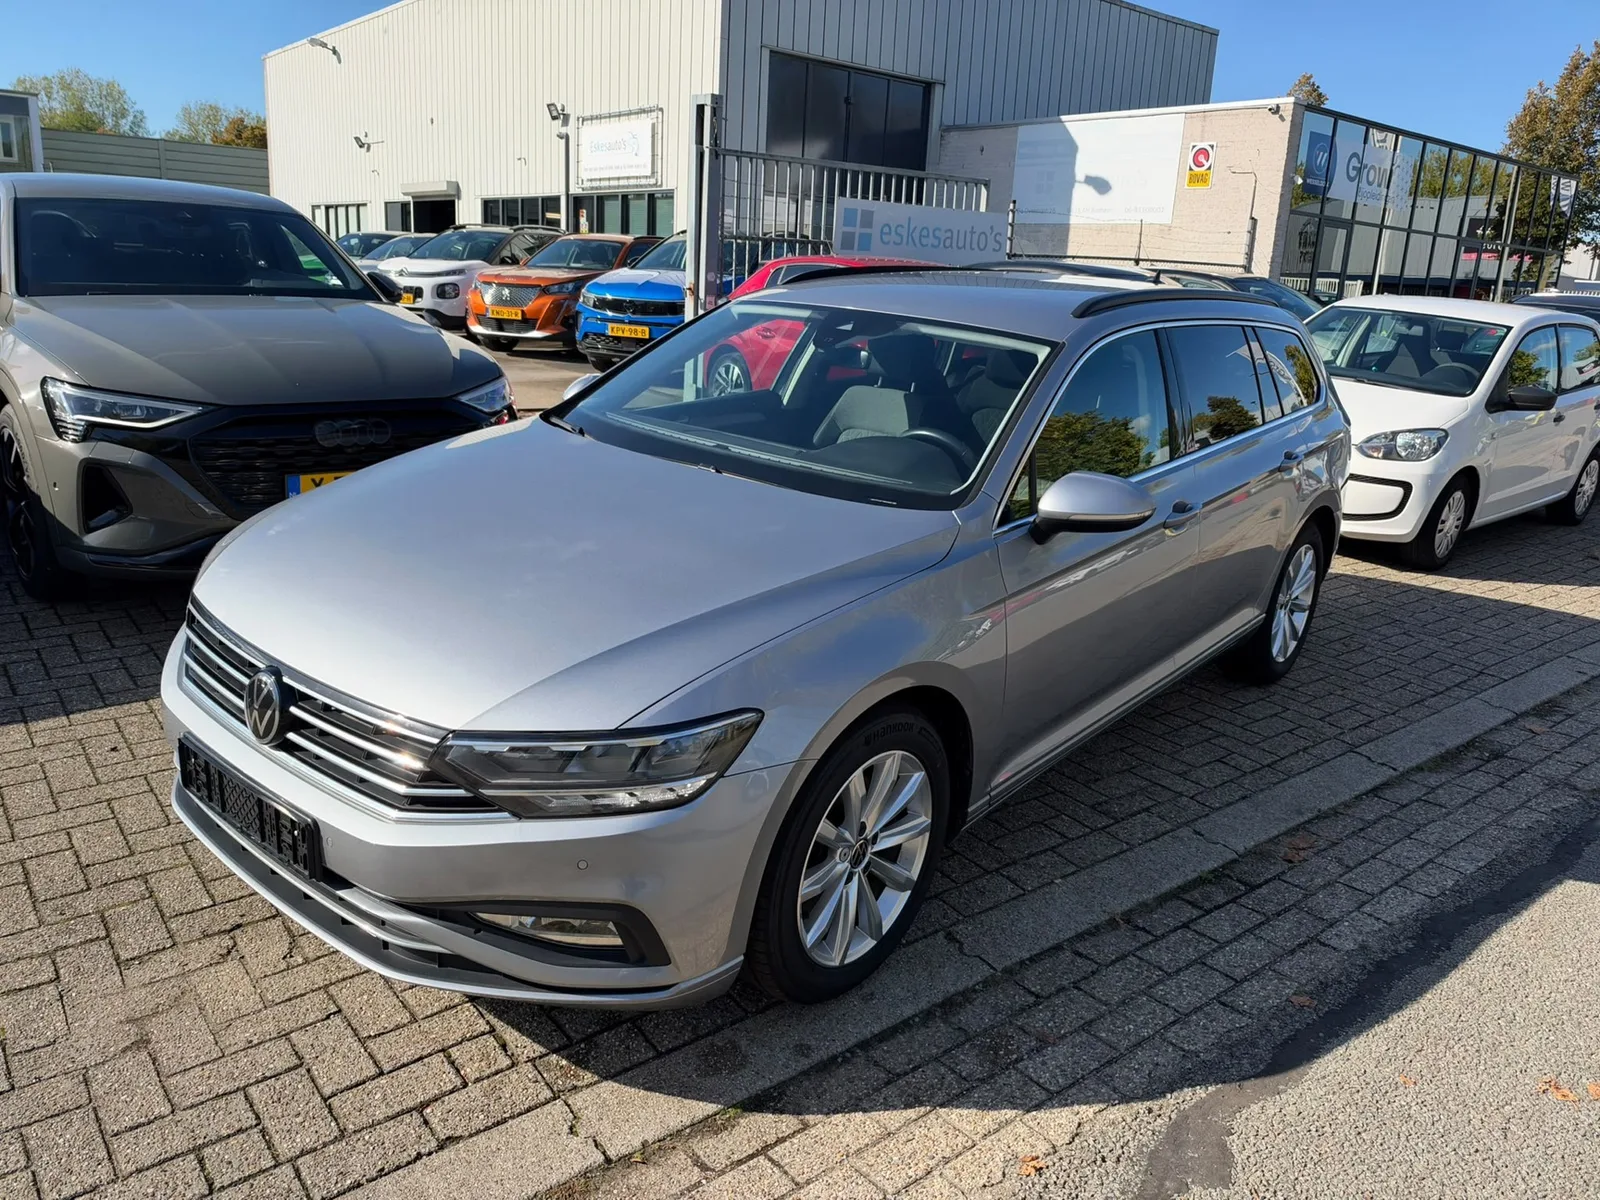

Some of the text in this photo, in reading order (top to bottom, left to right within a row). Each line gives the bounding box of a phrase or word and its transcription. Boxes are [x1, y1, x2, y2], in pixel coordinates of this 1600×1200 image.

[1188, 173, 1209, 184] BOVAG
[880, 216, 1002, 252] eskesauto's
[610, 325, 647, 337] KPV-98-B
